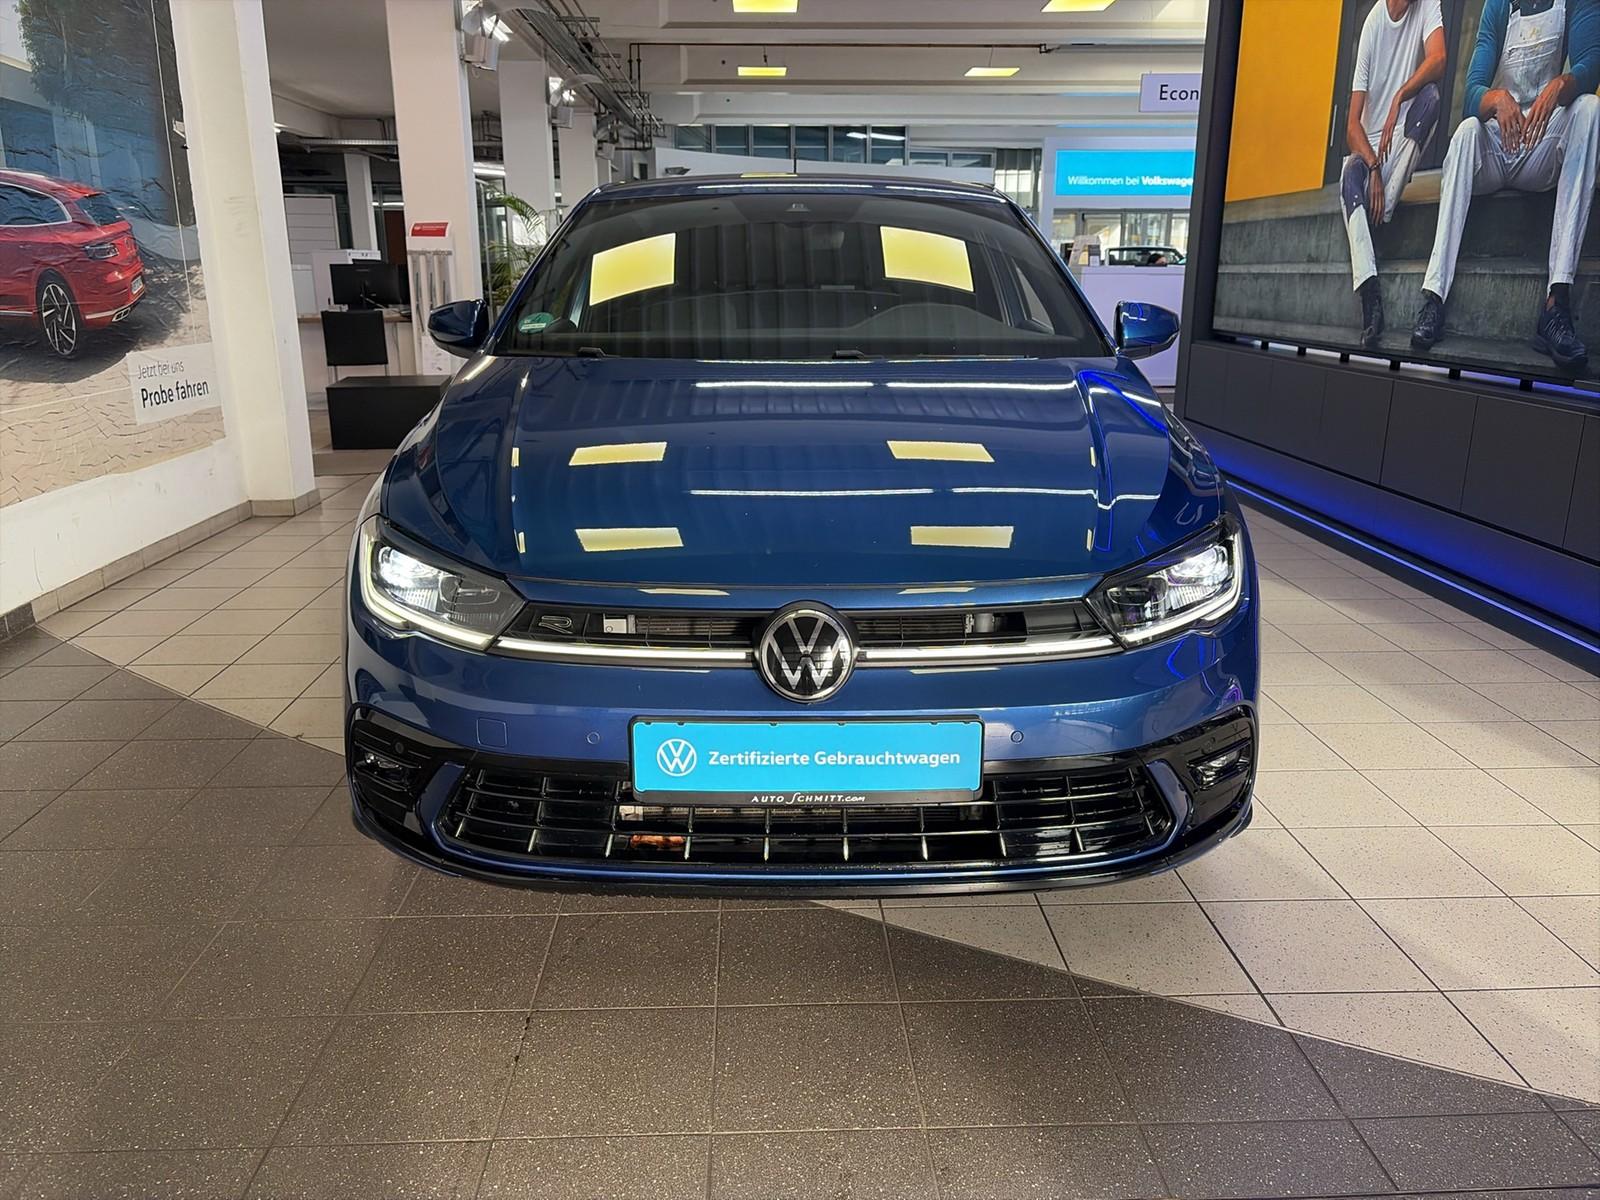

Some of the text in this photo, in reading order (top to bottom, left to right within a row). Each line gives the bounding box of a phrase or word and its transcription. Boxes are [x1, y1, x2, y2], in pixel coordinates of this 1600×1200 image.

[1159, 84, 1199, 101] Econ
[1067, 176, 1123, 185] Willkommen
[1125, 176, 1139, 185] bei
[138, 365, 157, 379] Jetzt
[158, 361, 170, 376] bei
[141, 379, 209, 408] Probe fahren
[708, 751, 809, 766] Zertifizierte
[814, 751, 961, 768] Gebrauchtwagen
[751, 795, 784, 803] AUTO
